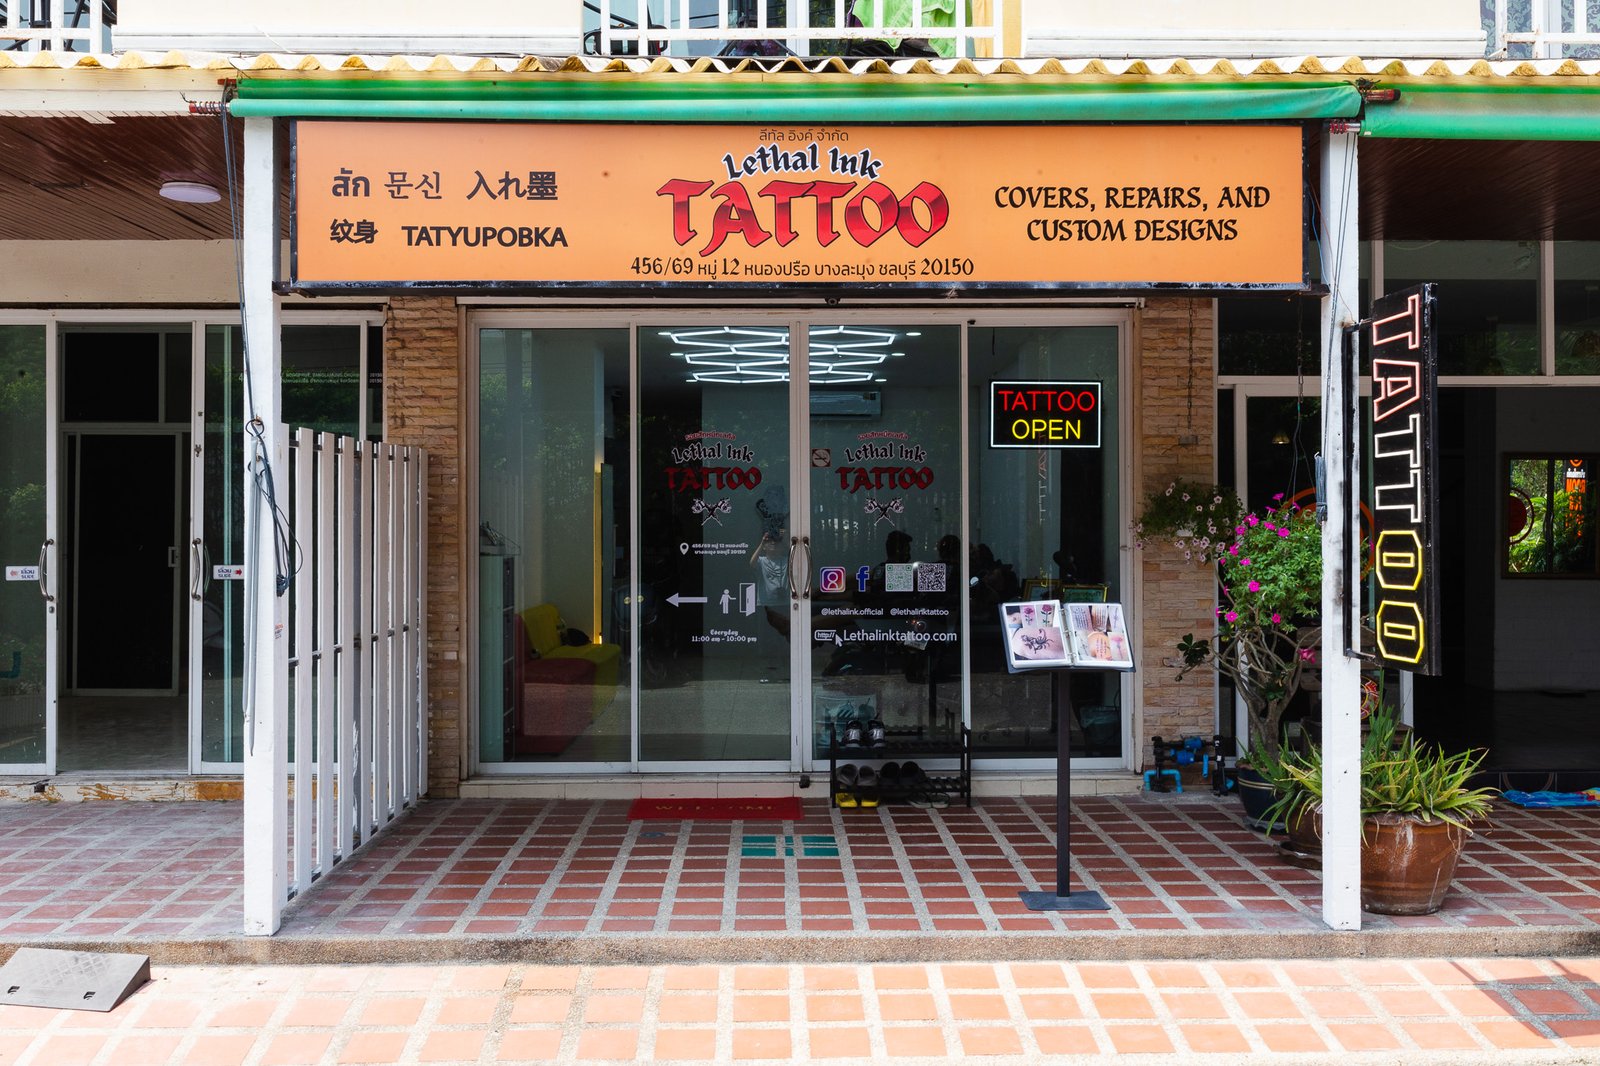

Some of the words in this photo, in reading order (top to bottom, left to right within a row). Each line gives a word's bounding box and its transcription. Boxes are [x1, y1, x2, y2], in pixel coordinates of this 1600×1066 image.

[759, 128, 785, 141] ลีทัล
[788, 128, 814, 141] อิงค์
[817, 128, 849, 141] จำกัด
[722, 143, 822, 180] Lethal
[828, 146, 882, 180] Ink
[331, 167, 371, 197] สัก
[383, 171, 443, 200] 문신
[466, 170, 559, 200] 入れ墨
[994, 186, 1096, 212] COVERS,
[1104, 186, 1209, 212] REPAIRS,
[1216, 186, 1271, 208] AND
[656, 178, 950, 257] TATTOO
[1026, 219, 1128, 242] CUSTOM
[1134, 219, 1239, 242] DESIGNS
[329, 218, 379, 245] 纹身
[630, 256, 694, 276] 456/69
[698, 259, 718, 280] หมู่
[721, 257, 741, 276] 12
[744, 260, 811, 277] หนองปรือ
[814, 264, 875, 281] บางละมุง
[879, 260, 917, 281] ชลบุรี
[920, 257, 975, 277] 20150
[998, 390, 1095, 412] TATTOO
[1012, 419, 1081, 440] OPEN
[671, 441, 722, 464] Lethal
[726, 444, 755, 463] Ink
[844, 441, 895, 464] Lethal
[899, 443, 927, 463] Ink
[664, 466, 762, 493] TATTOO
[834, 466, 934, 494] TATTOO
[1372, 293, 1425, 664] TATTOO
[843, 629, 958, 642] Lethalinktattoo.com
